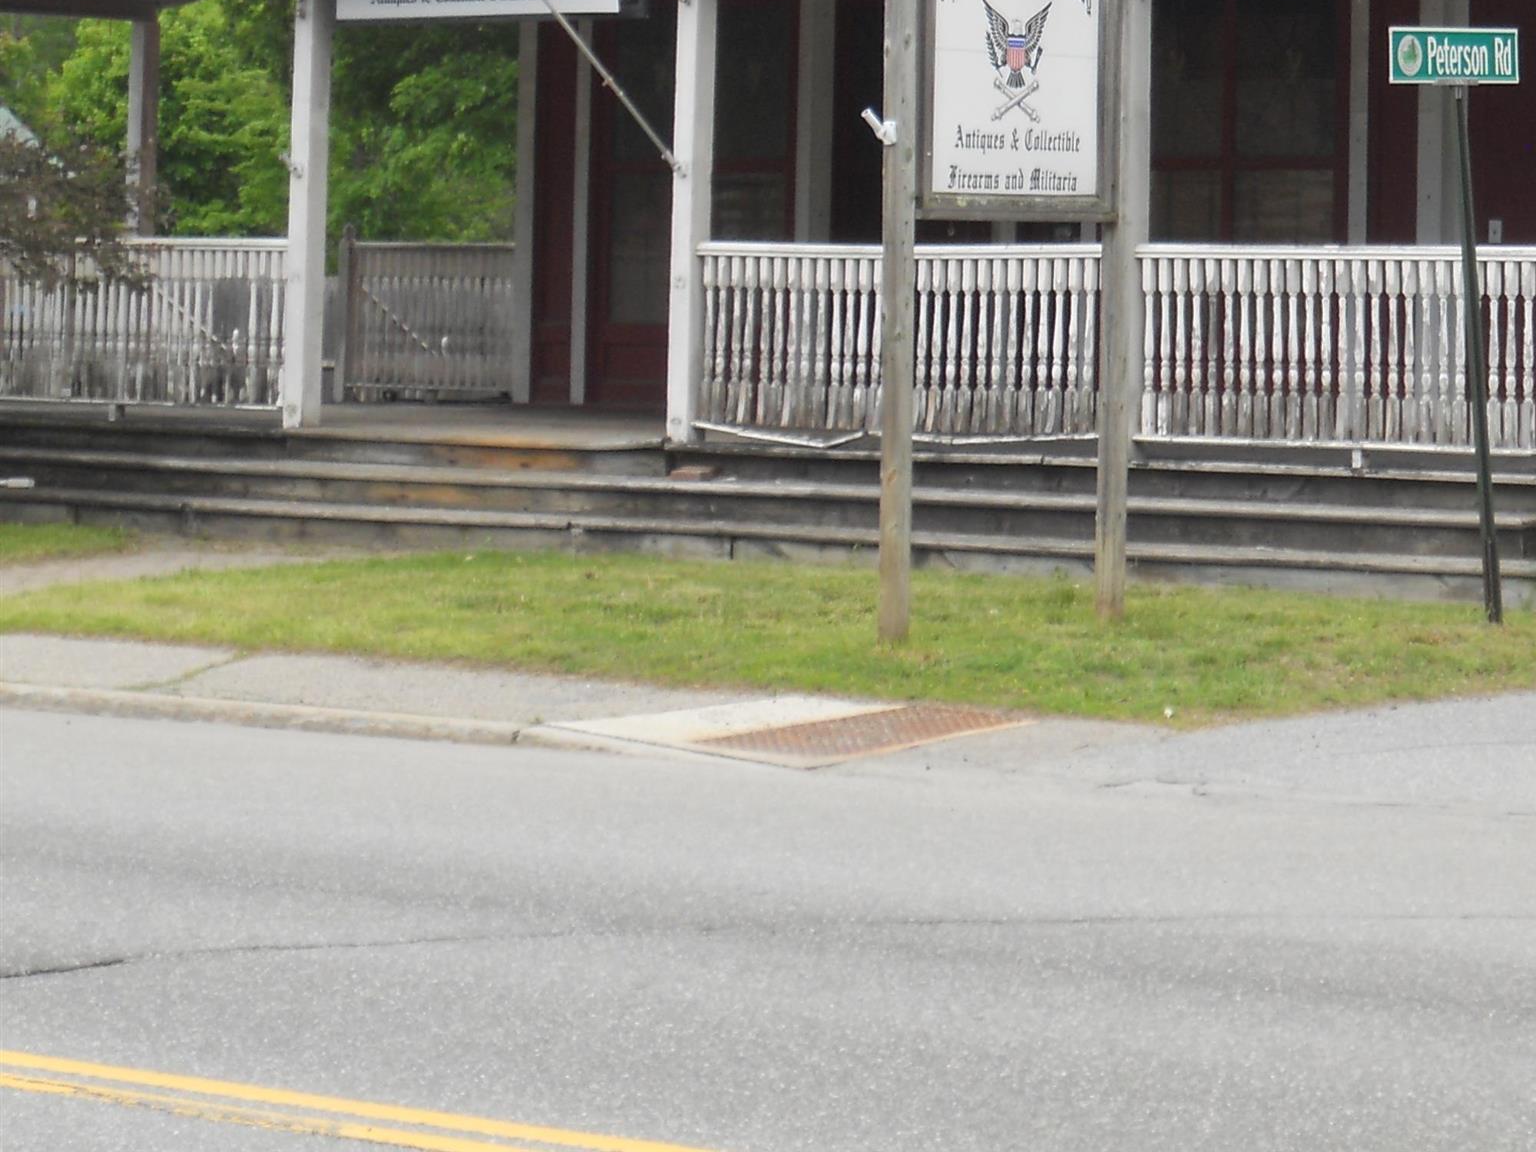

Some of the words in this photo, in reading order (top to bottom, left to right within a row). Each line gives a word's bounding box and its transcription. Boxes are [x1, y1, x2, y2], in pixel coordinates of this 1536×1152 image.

[1427, 36, 1488, 75] Peterson
[1494, 37, 1512, 75] Rd
[954, 124, 1005, 154] Antiques
[1010, 127, 1019, 151] &
[1024, 128, 1080, 152] Collectible
[947, 164, 999, 190] Firearms
[1004, 167, 1024, 190] and
[1029, 166, 1078, 192] Militaria
